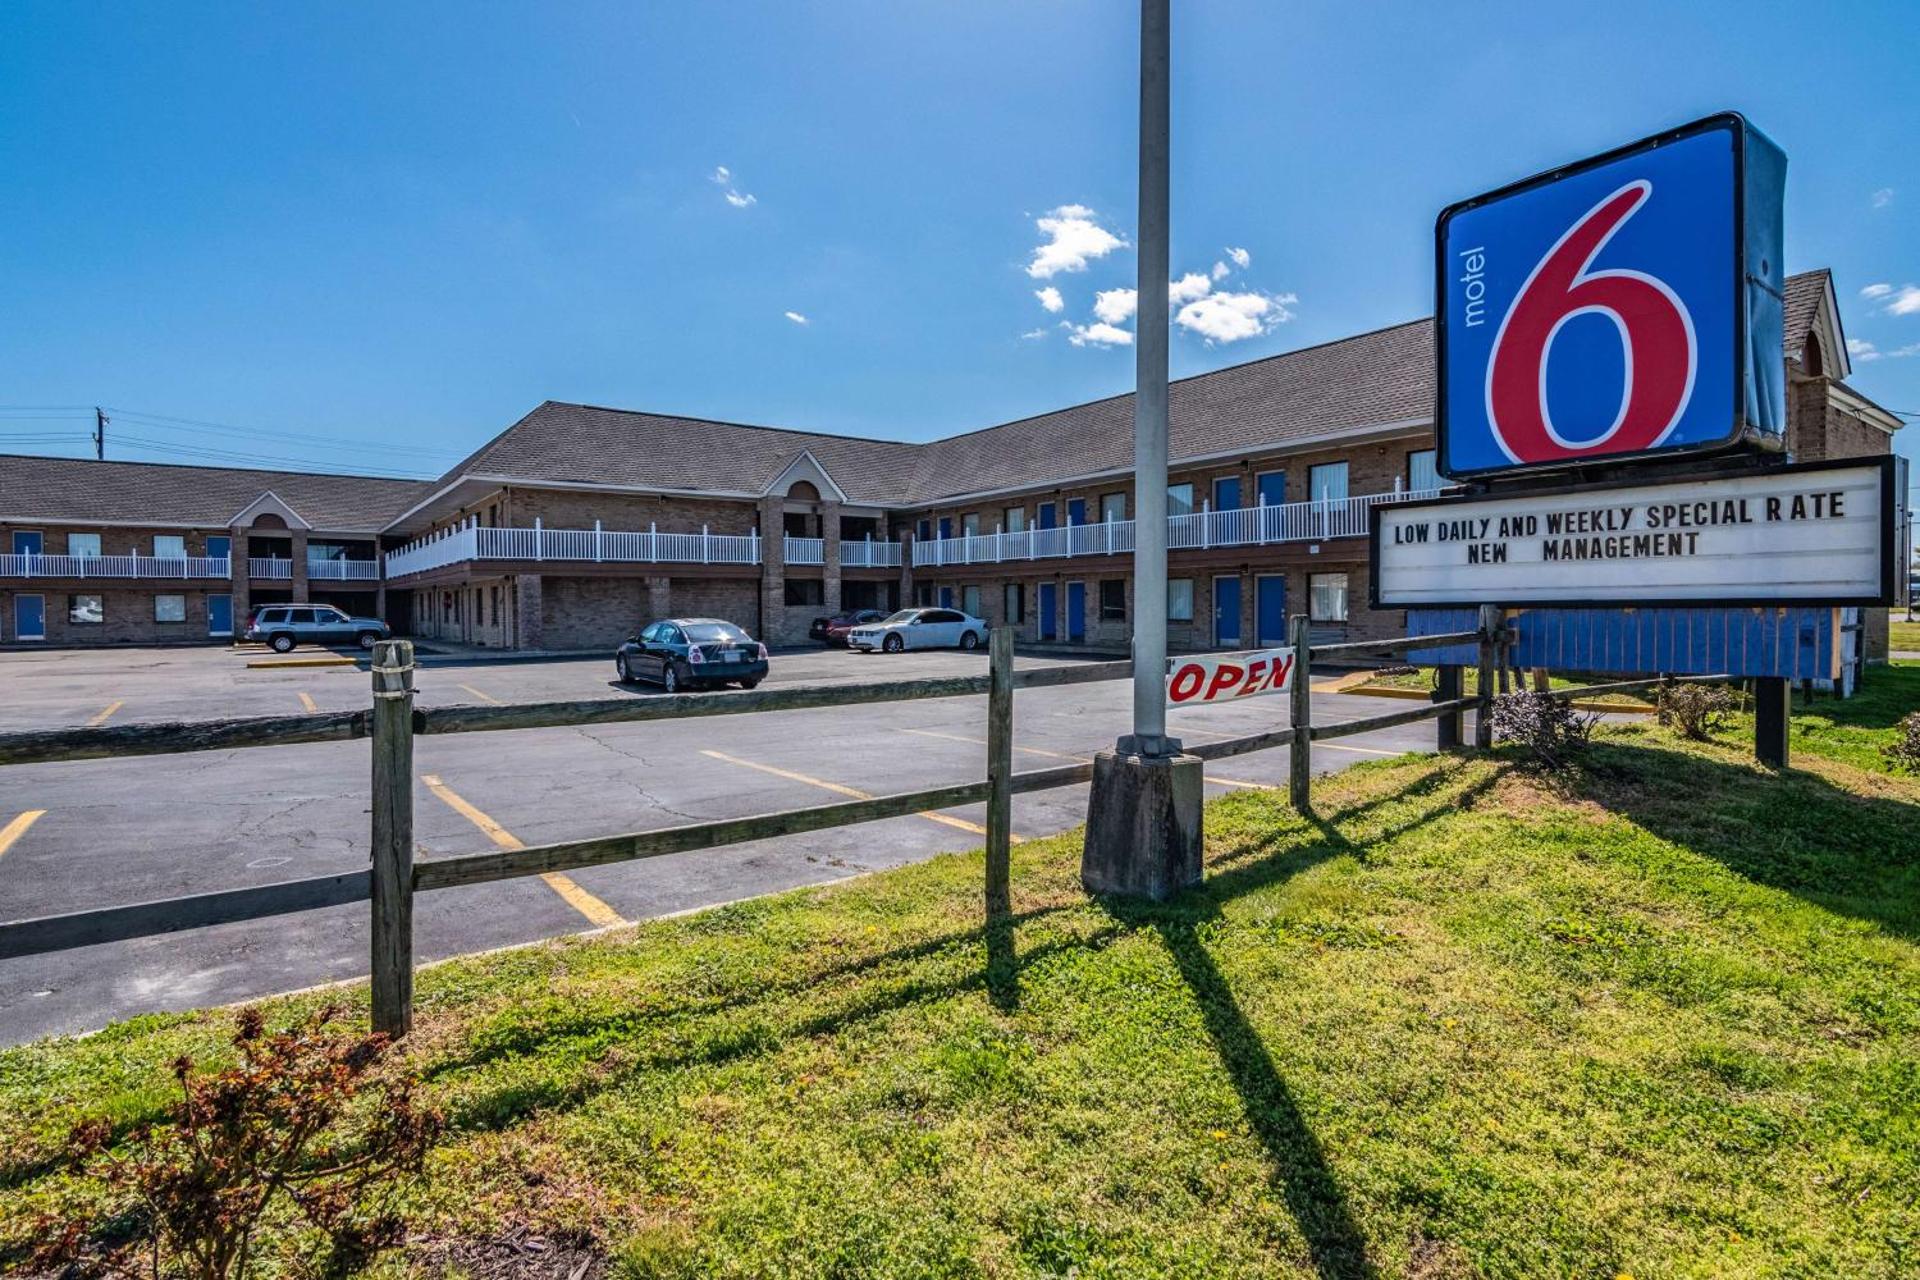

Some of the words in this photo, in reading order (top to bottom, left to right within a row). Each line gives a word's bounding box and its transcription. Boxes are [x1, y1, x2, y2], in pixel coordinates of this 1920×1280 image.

[1459, 246, 1485, 328] motel
[1484, 178, 1698, 464] 6
[1395, 523, 1430, 544] LOW
[1438, 518, 1490, 541] DAILY
[1498, 515, 1537, 537] AND
[1546, 507, 1634, 535] WEEKLY
[1646, 499, 1753, 528] SPECIAL
[1467, 542, 1507, 564] NEW
[1543, 531, 1700, 562] MANAGEMENT
[1169, 653, 1294, 703] OPEN
